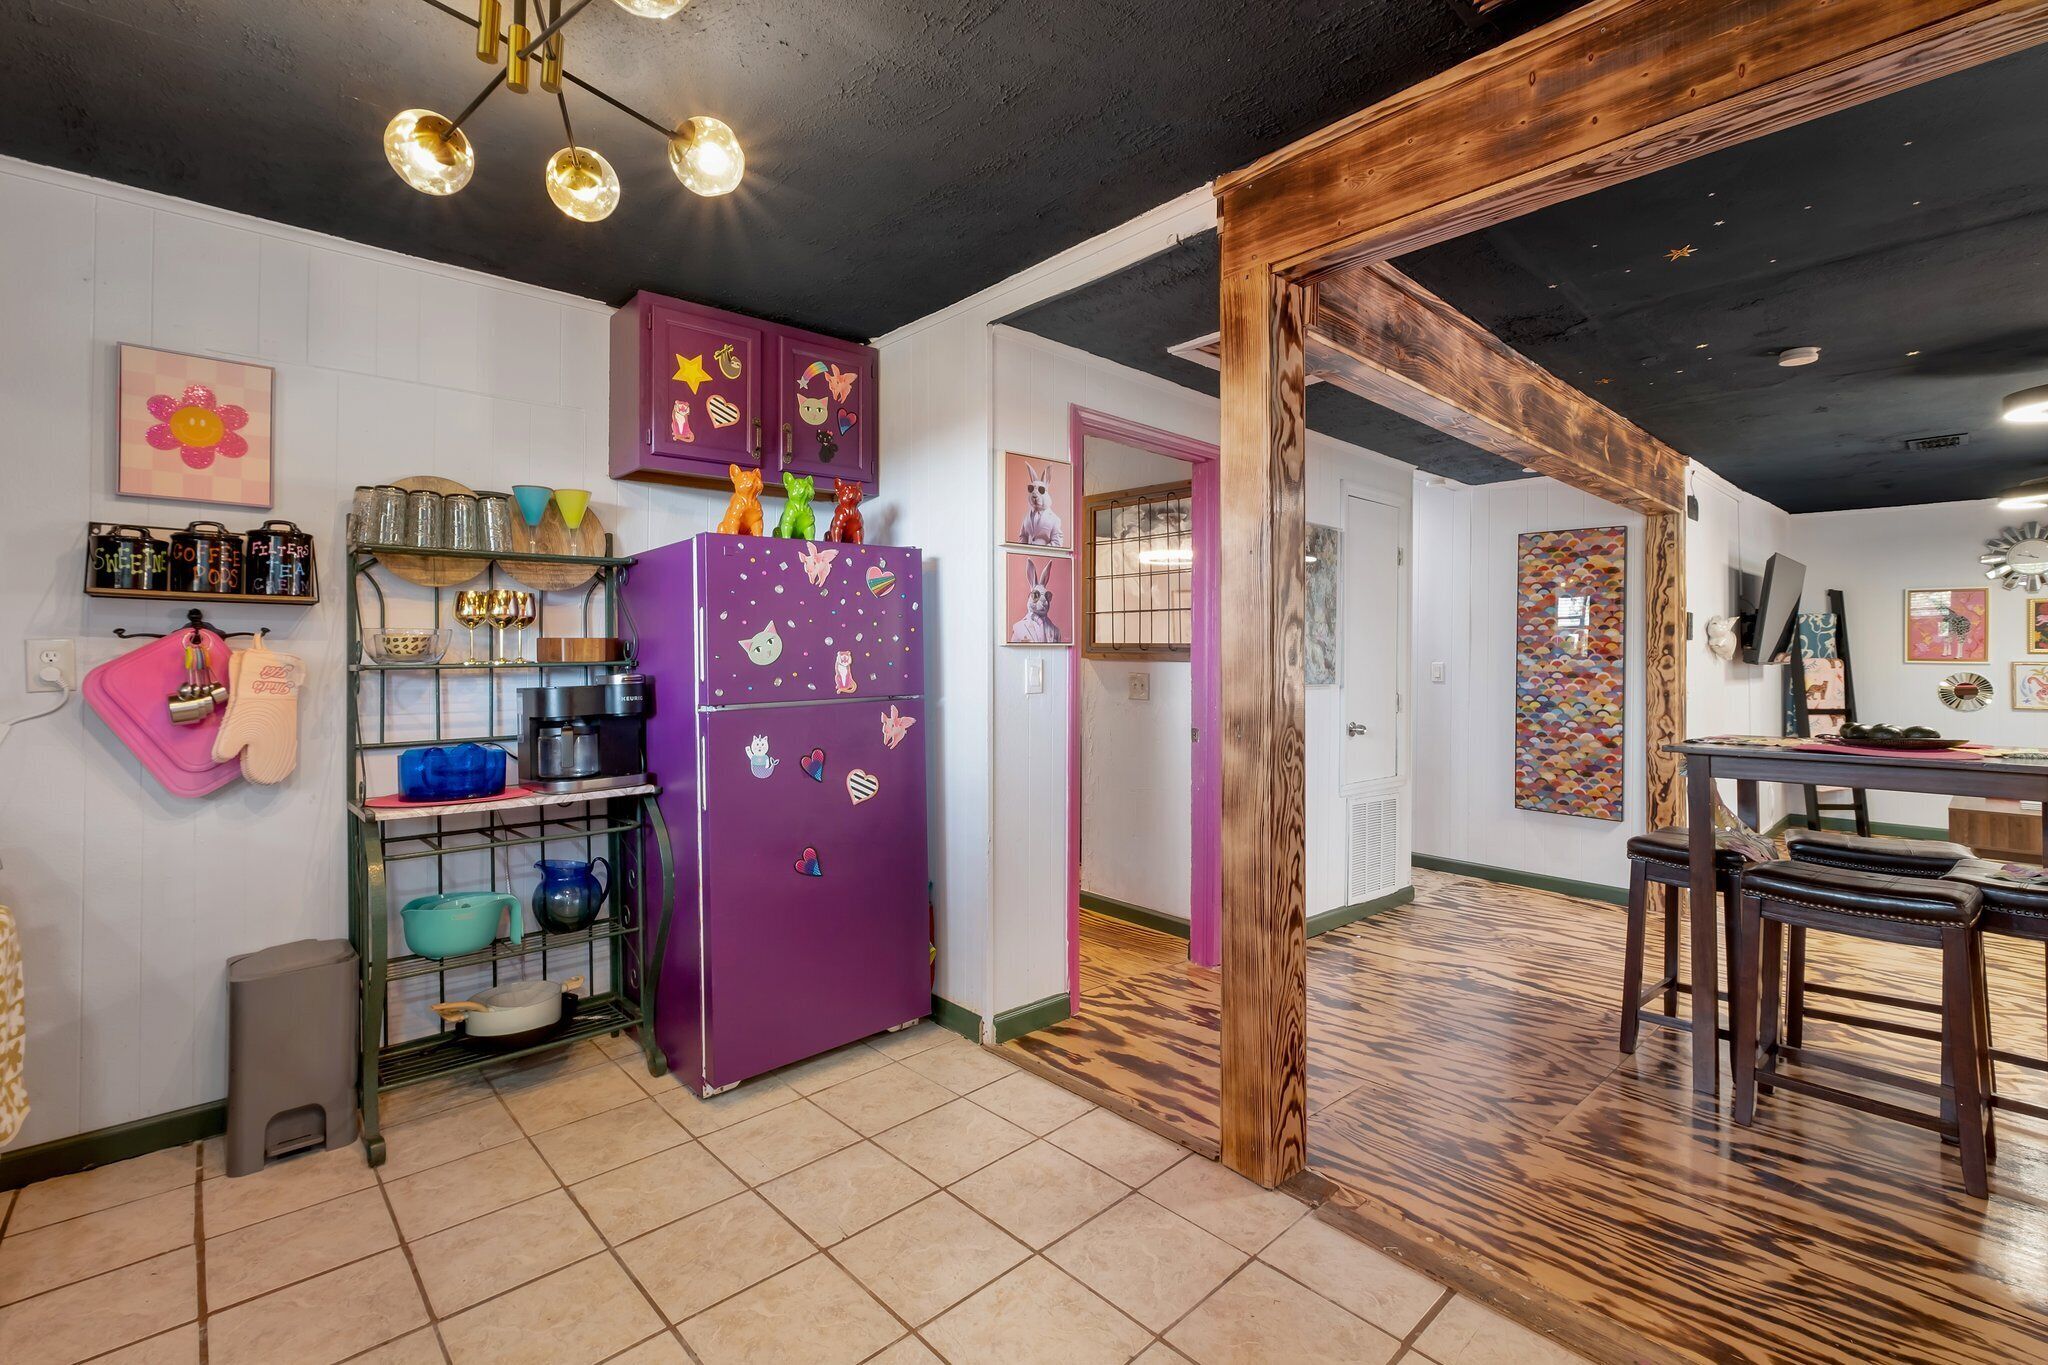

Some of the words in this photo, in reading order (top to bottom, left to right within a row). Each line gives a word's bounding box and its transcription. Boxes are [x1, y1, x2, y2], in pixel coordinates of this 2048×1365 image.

[173, 543, 241, 567] COFFEE
[252, 541, 309, 558] FILTERS
[193, 566, 238, 588] PODS
[265, 559, 305, 577] TEA
